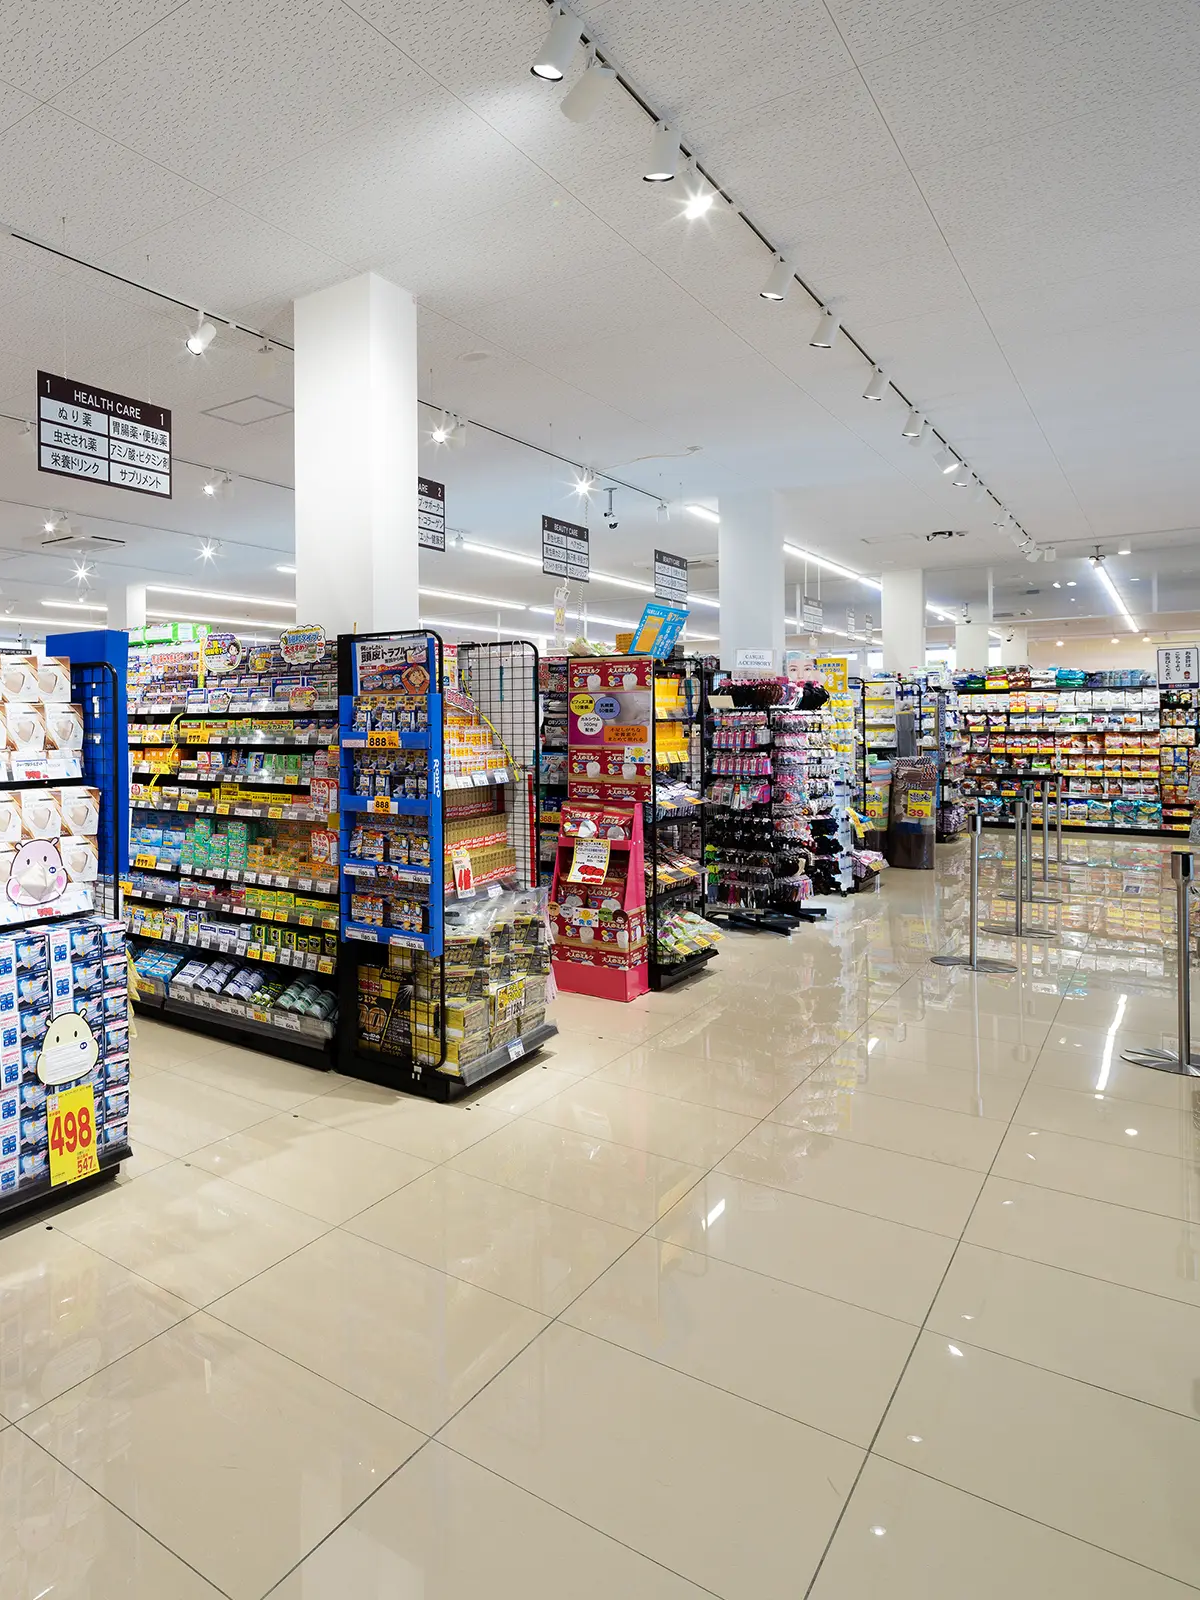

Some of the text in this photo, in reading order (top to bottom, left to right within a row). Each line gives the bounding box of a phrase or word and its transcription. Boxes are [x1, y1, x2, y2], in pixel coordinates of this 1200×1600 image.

[46, 379, 164, 426] 1 HEALTH CARE 1
[58, 407, 92, 427] ぬり薬
[53, 429, 97, 452] 虫さされ薬
[51, 452, 100, 475] 栄養ドリンク
[119, 468, 162, 489] サプリメント
[369, 737, 387, 747] 888
[432, 759, 441, 798] ROHTO
[375, 800, 390, 809] 888
[909, 809, 924, 817] 39
[51, 1107, 92, 1156] 498
[77, 1156, 93, 1174] 547
